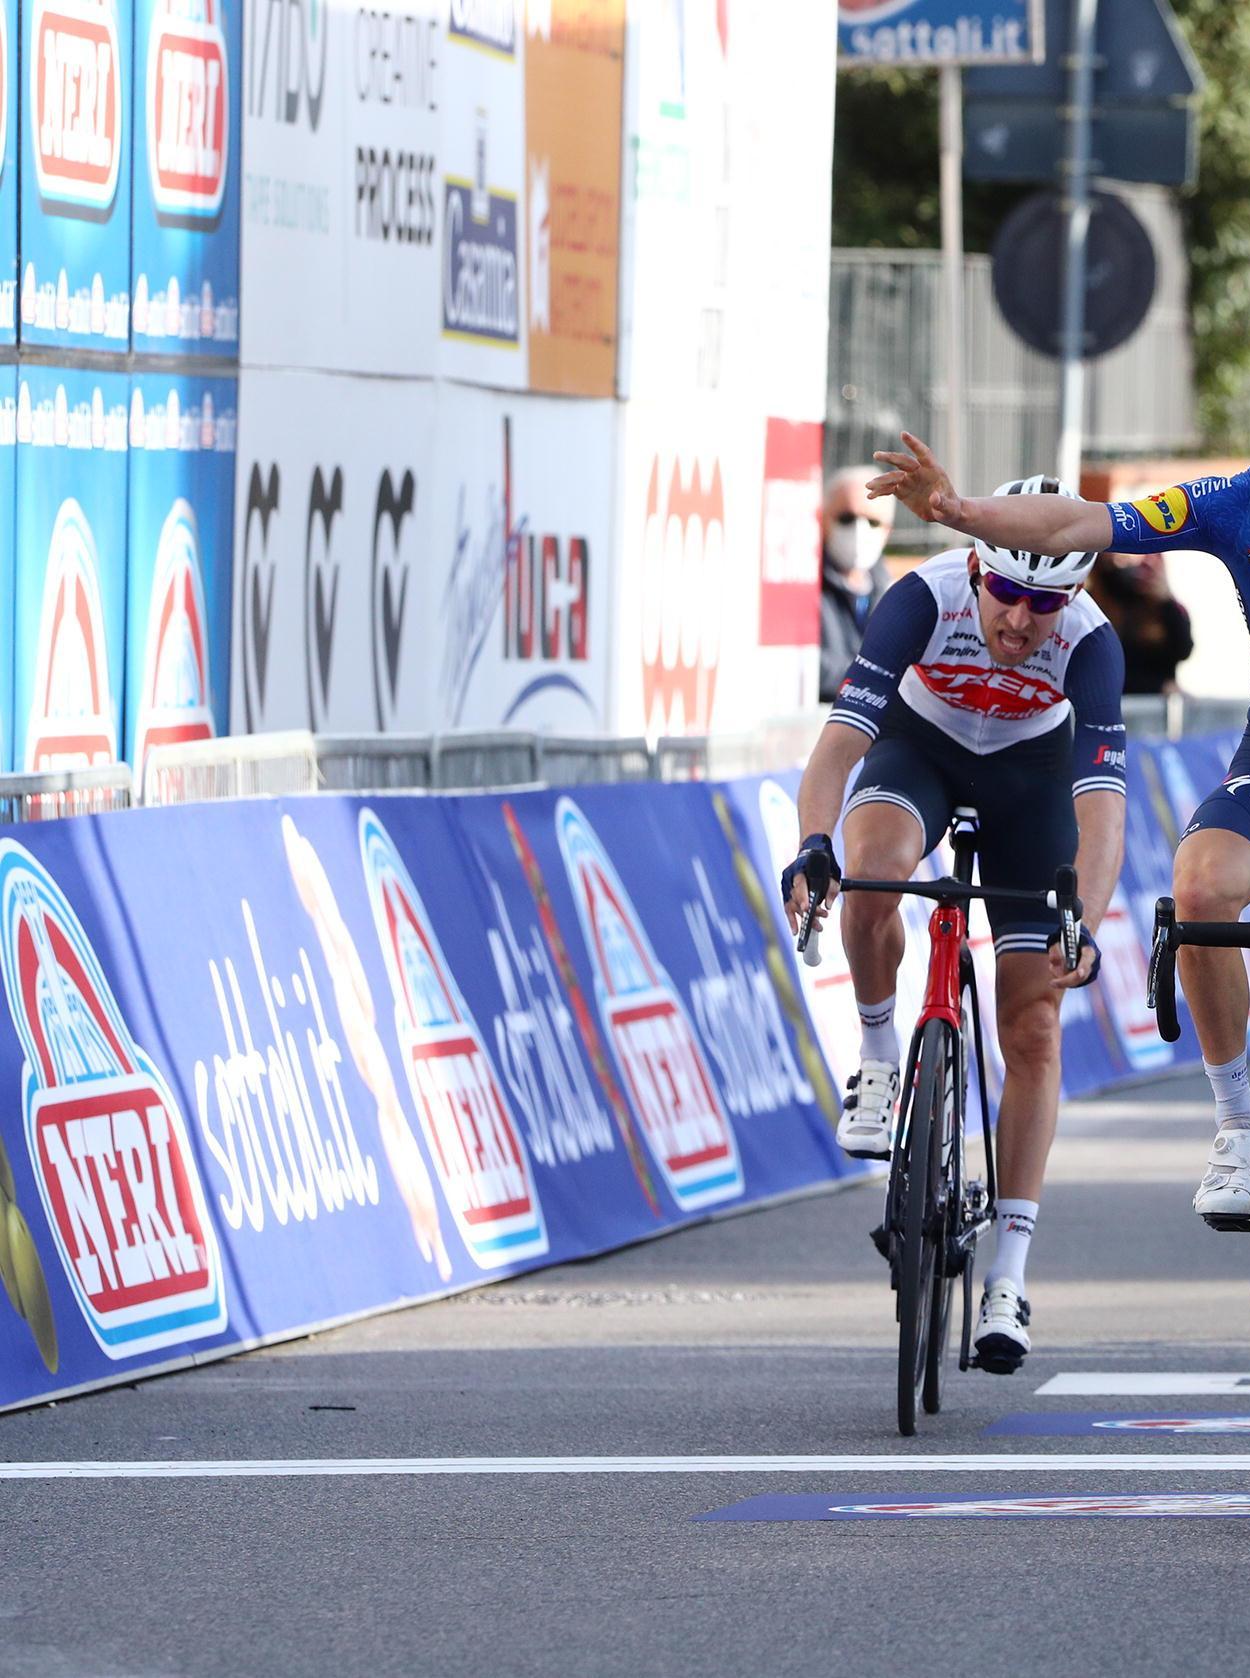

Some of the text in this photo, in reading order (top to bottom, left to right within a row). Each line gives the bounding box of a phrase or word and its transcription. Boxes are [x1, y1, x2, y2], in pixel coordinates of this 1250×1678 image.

[41, 29, 113, 168] NERI
[159, 49, 221, 178] NERI
[355, 146, 435, 247] PROCESS
[1192, 476, 1232, 499] crivit
[416, 1055, 527, 1208] NERI
[616, 1020, 728, 1160] NERI
[42, 1108, 203, 1294] NERI
